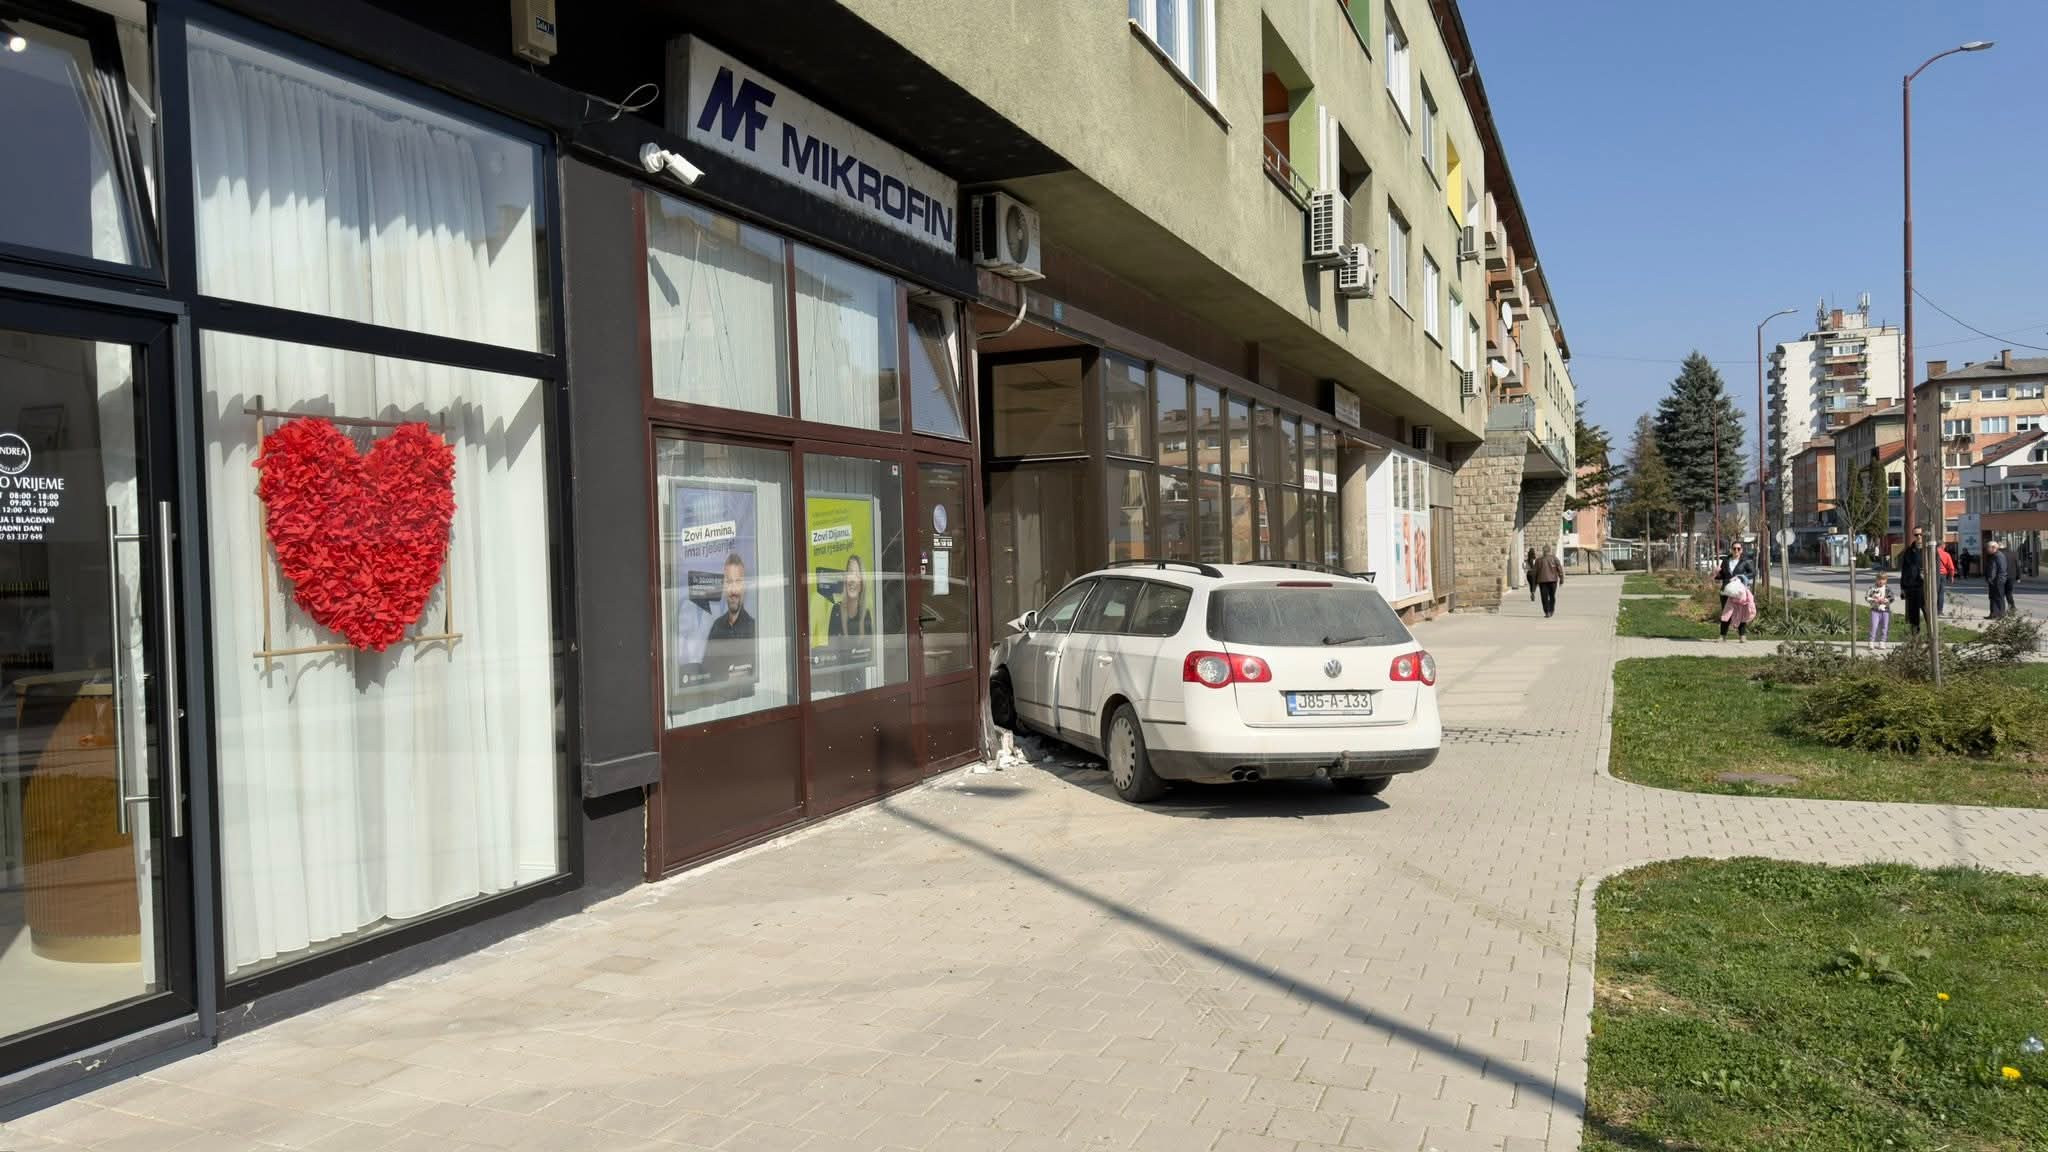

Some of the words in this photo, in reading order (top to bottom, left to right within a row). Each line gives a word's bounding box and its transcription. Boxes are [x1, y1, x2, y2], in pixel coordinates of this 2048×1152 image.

[697, 65, 777, 152] MF
[782, 121, 953, 243] MIKROFIN
[13, 477, 64, 491] VRIJEME
[684, 529, 702, 542] Zovi
[704, 525, 735, 539] Armina,
[813, 531, 828, 542] Zovi
[1298, 694, 1369, 709] J85-A-133
